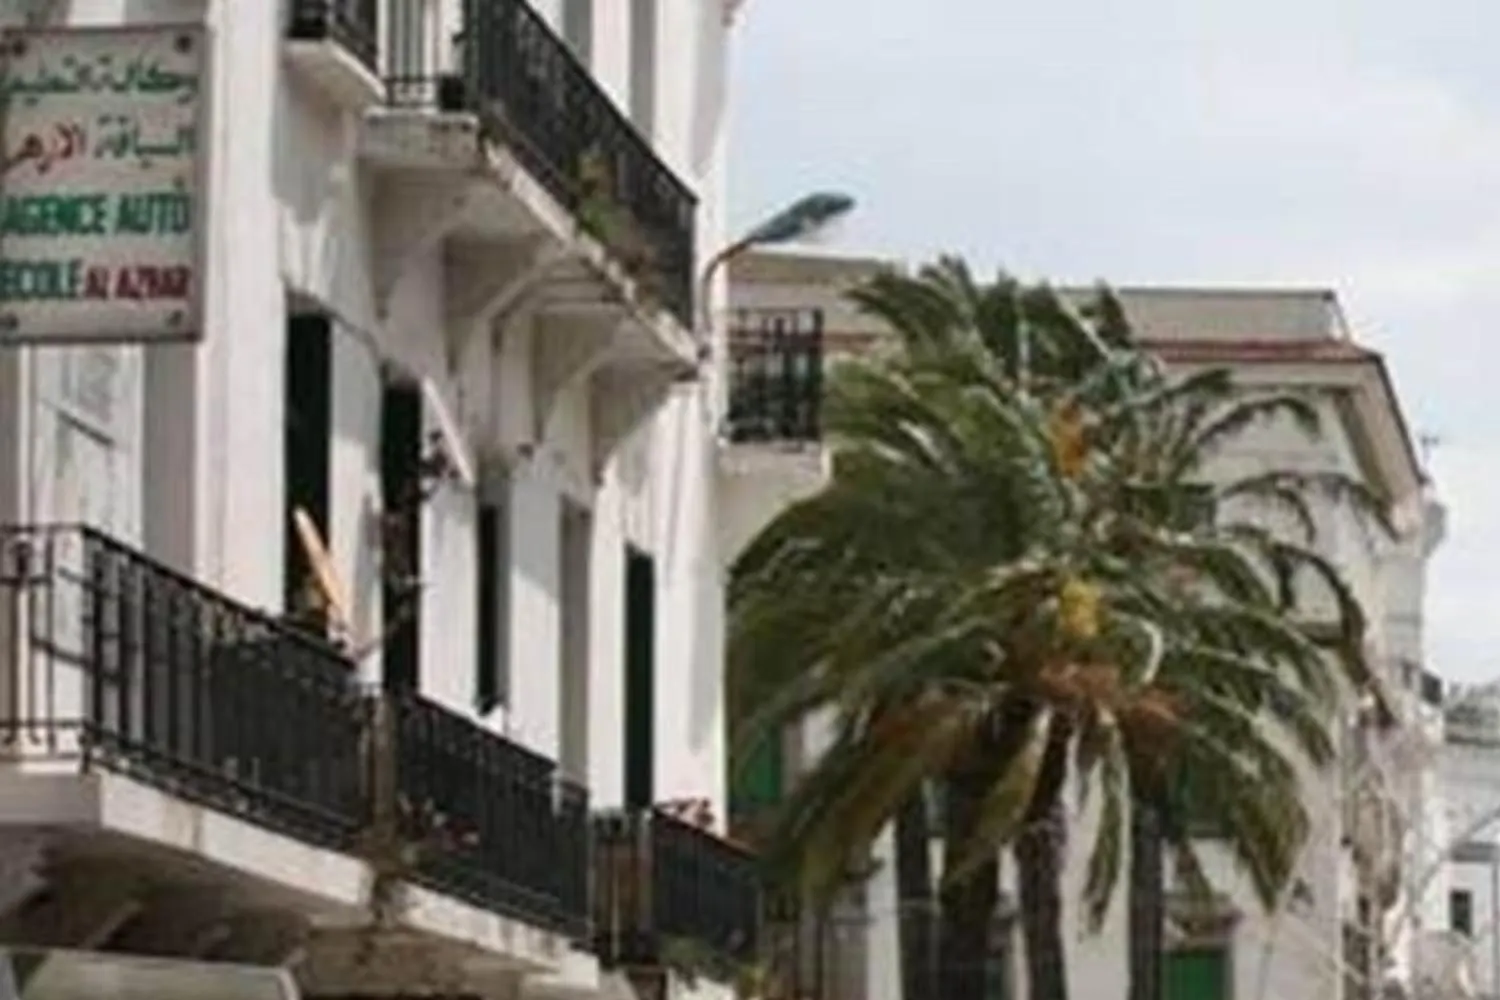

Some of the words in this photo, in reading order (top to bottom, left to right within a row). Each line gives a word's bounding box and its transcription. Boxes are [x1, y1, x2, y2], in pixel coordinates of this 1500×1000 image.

[3, 194, 106, 236] AGENCE
[115, 192, 191, 235] AUTO
[0, 259, 83, 301] ECOLE
